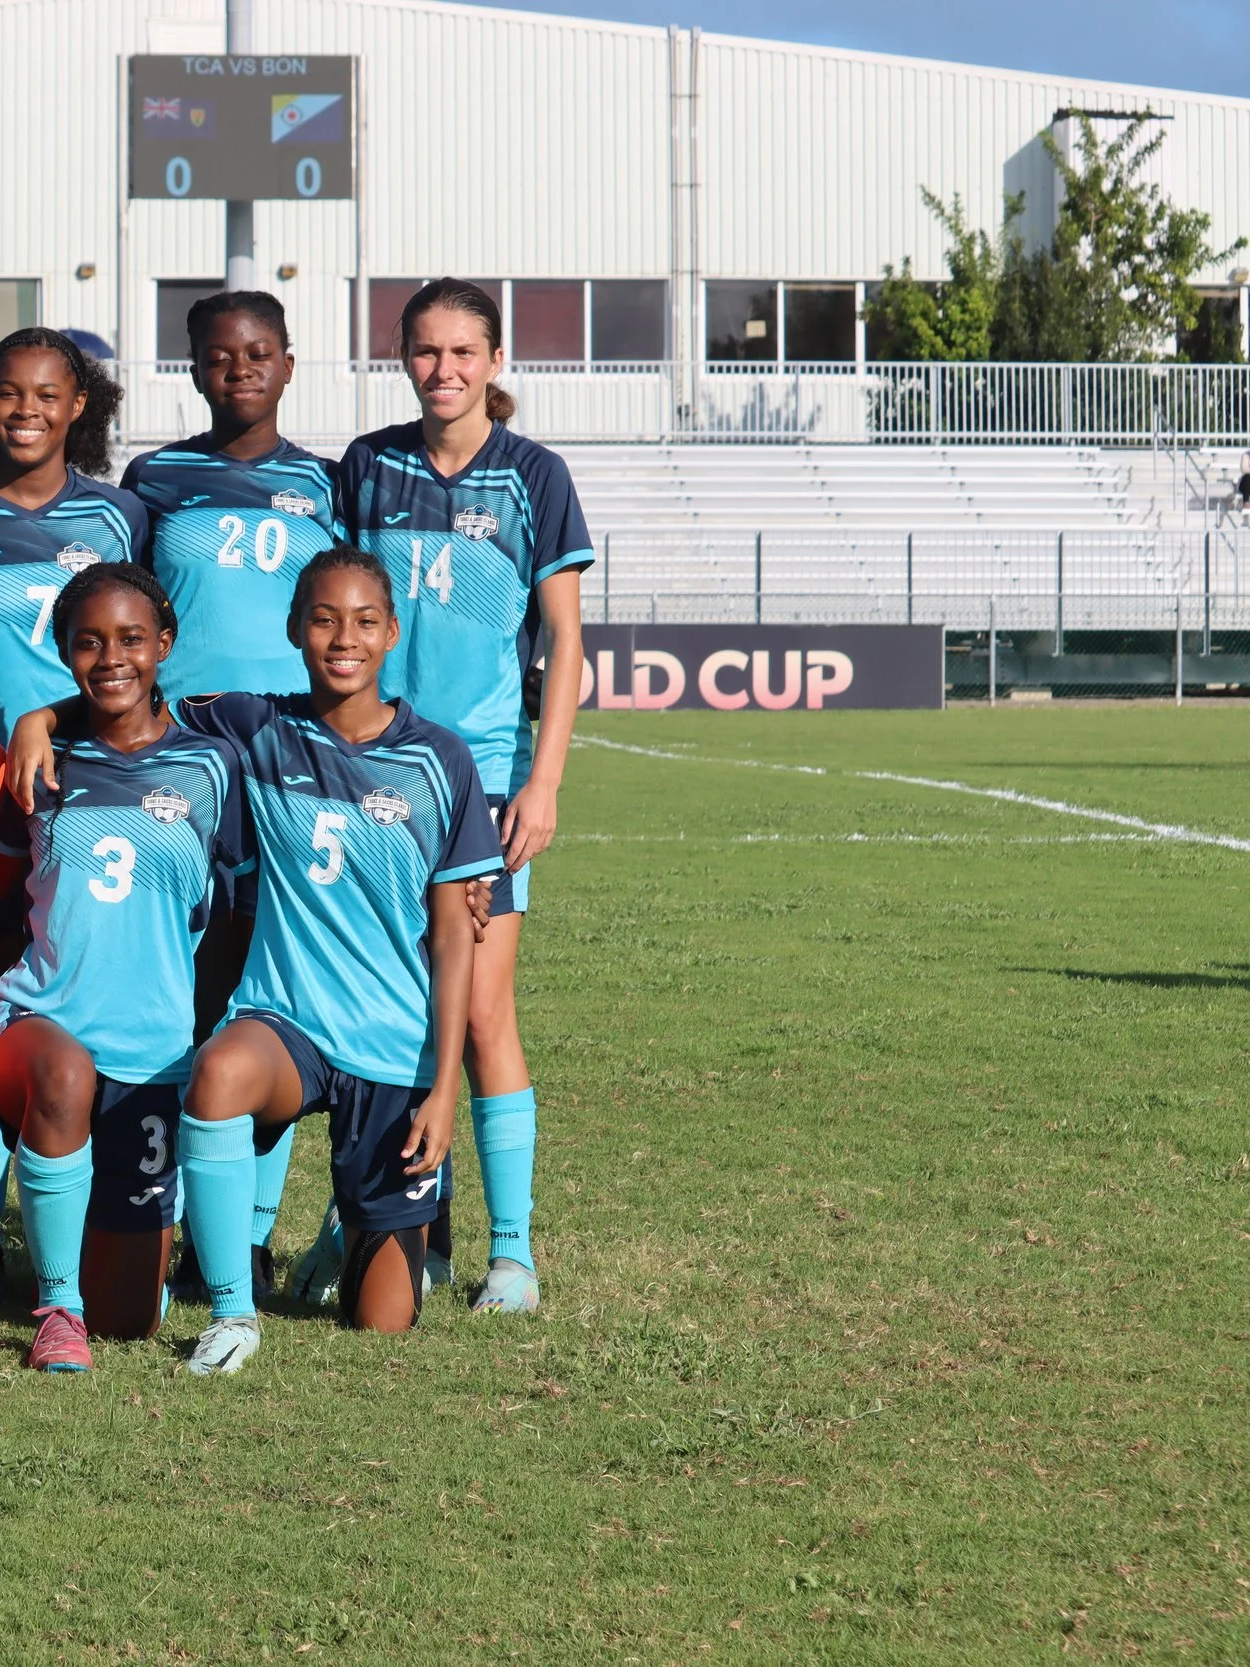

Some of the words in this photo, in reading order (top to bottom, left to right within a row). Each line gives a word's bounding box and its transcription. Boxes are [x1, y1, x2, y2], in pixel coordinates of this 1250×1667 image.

[182, 57, 225, 76] TCA
[228, 57, 257, 76] VS
[261, 57, 307, 76] BON
[165, 156, 192, 197] 0
[295, 156, 322, 197] 0
[217, 515, 289, 572] 20
[407, 539, 454, 604] 14
[26, 585, 59, 646] 7
[698, 649, 854, 710] CUP
[88, 835, 136, 904] 3
[307, 811, 347, 885] 5
[138, 1115, 168, 1175] 3
[253, 1203, 277, 1214] oma
